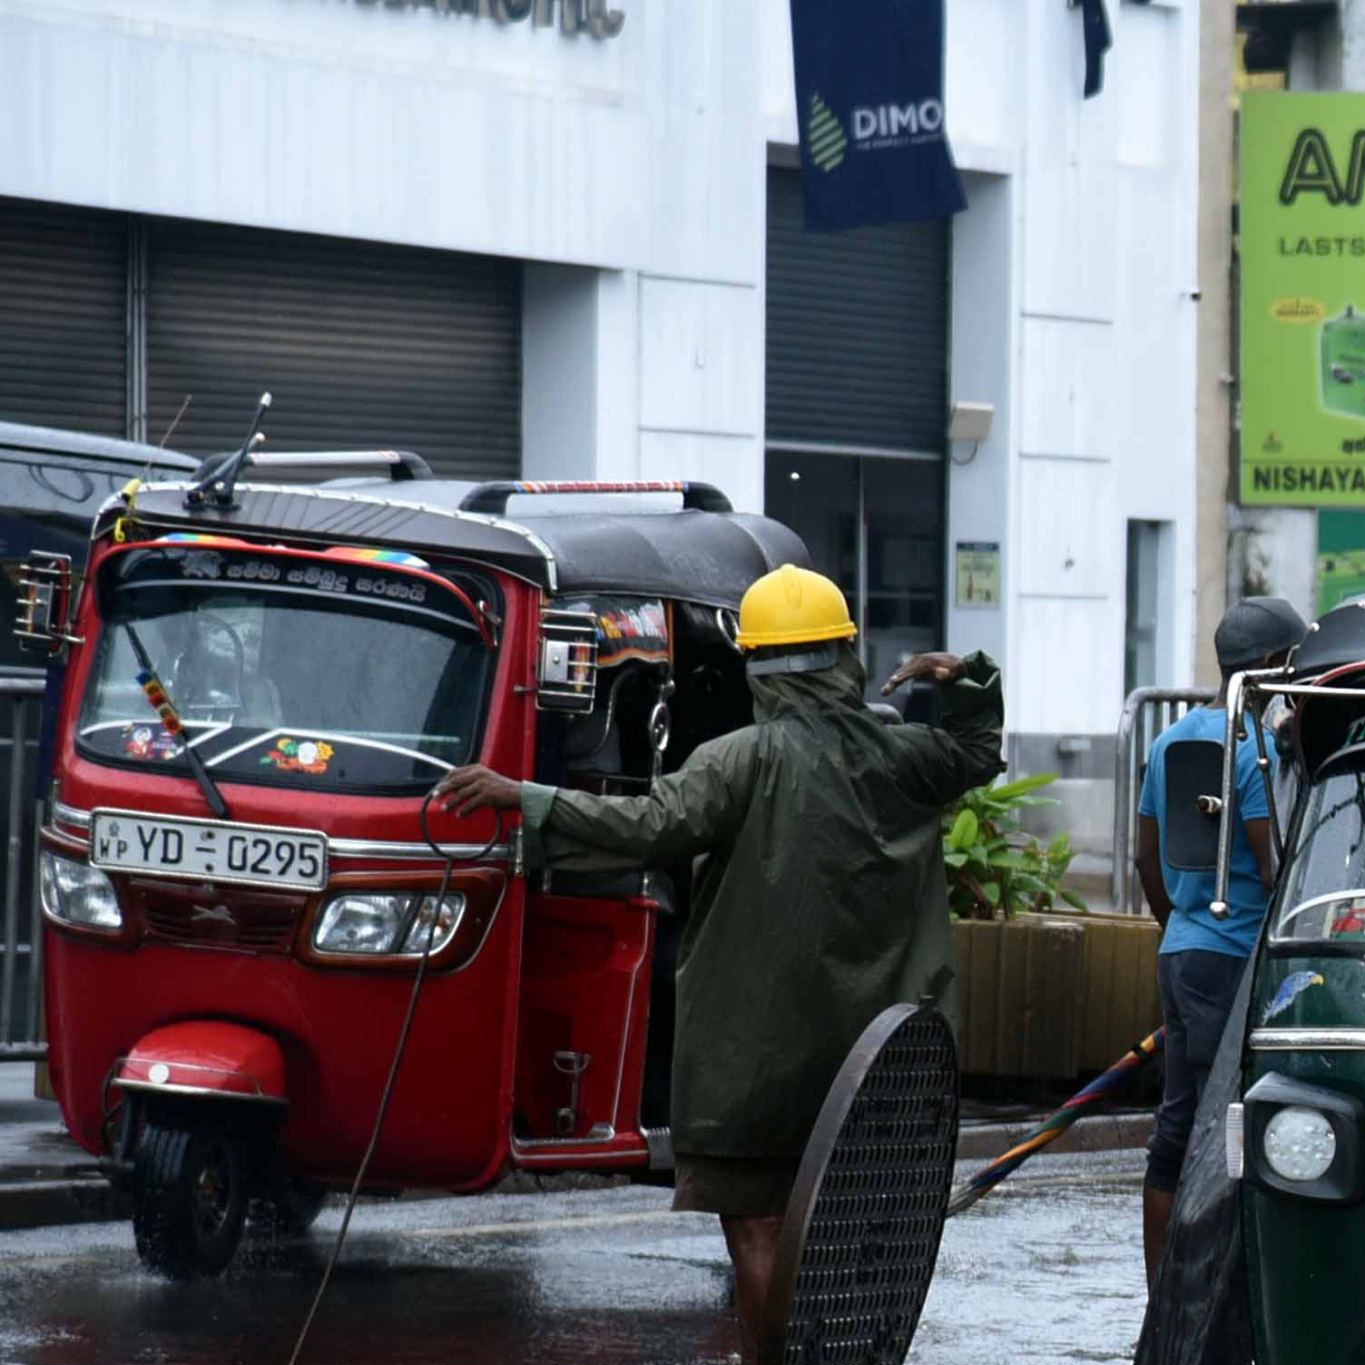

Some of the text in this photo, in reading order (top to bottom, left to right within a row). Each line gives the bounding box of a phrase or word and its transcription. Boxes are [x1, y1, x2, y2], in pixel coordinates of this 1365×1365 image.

[854, 101, 943, 139] DIMO
[1279, 238, 1365, 257] LASTS
[138, 825, 183, 865] YD
[228, 836, 319, 878] 0295
